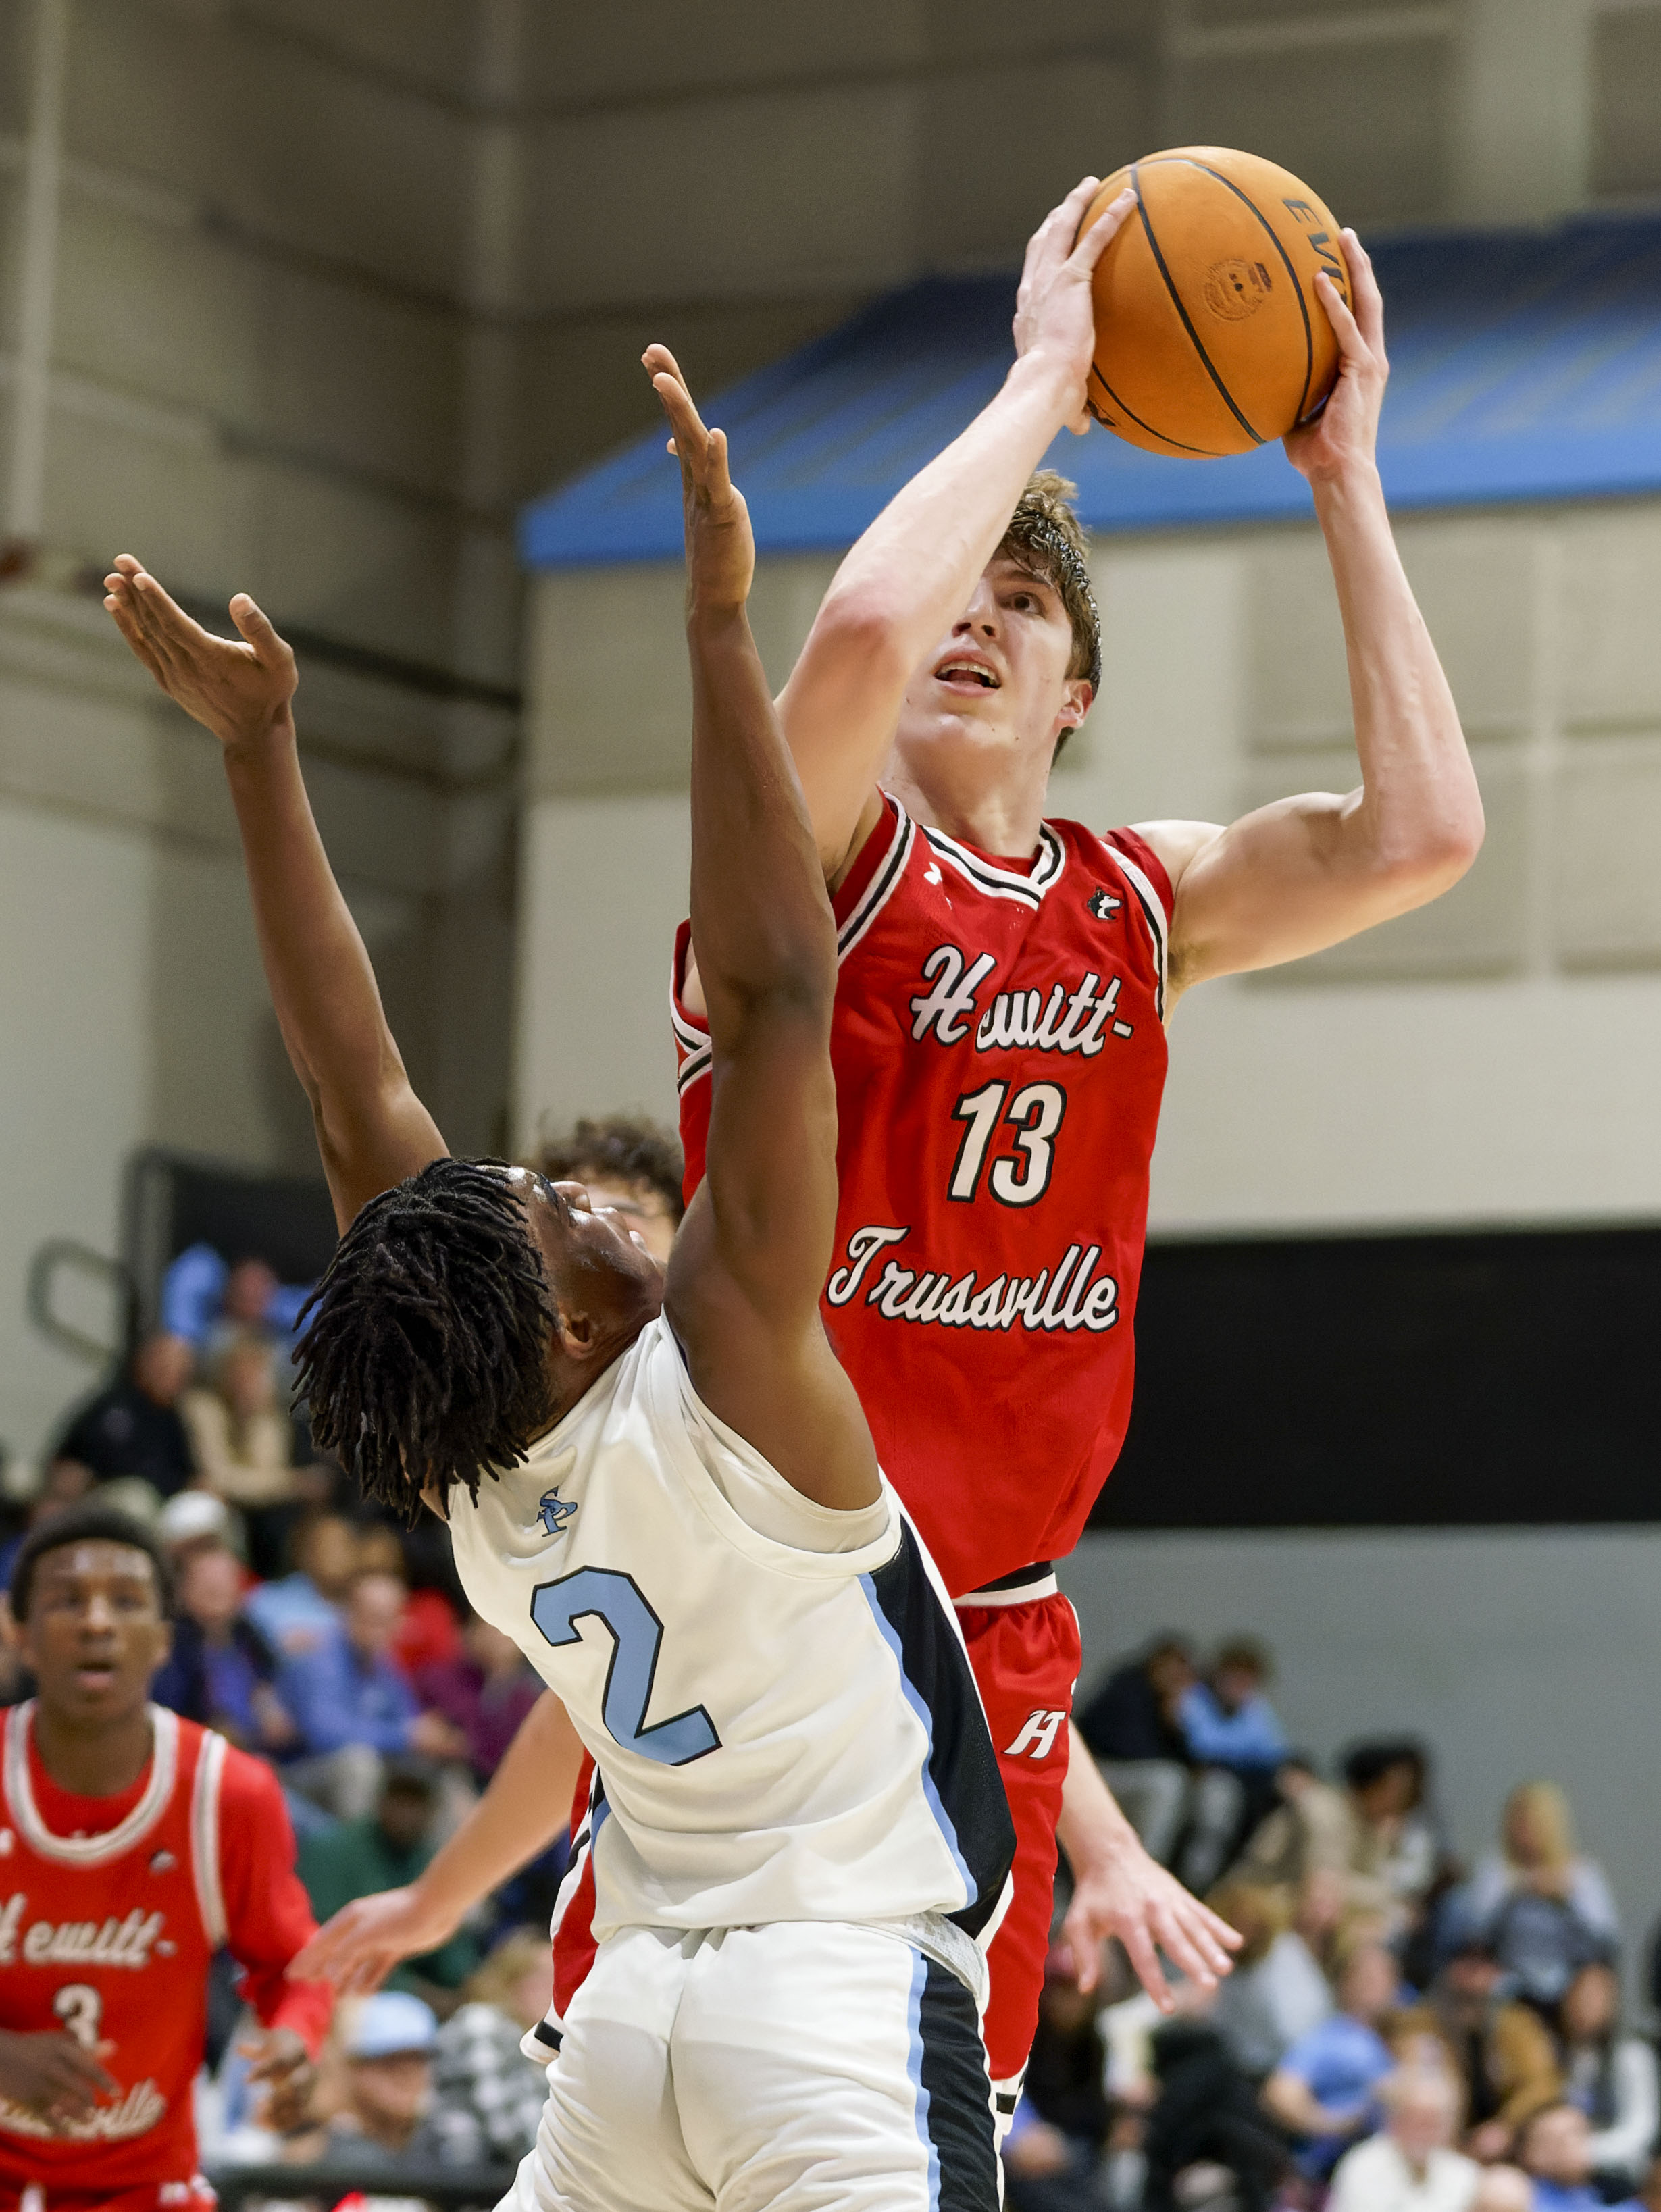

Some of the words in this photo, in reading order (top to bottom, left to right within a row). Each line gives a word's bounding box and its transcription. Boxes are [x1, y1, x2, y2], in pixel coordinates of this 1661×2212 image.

[909, 943, 1135, 1058] Hewitt-
[946, 1078, 1068, 1209] 13
[826, 1225, 1119, 1334] Trussville
[530, 1565, 723, 1767] 2
